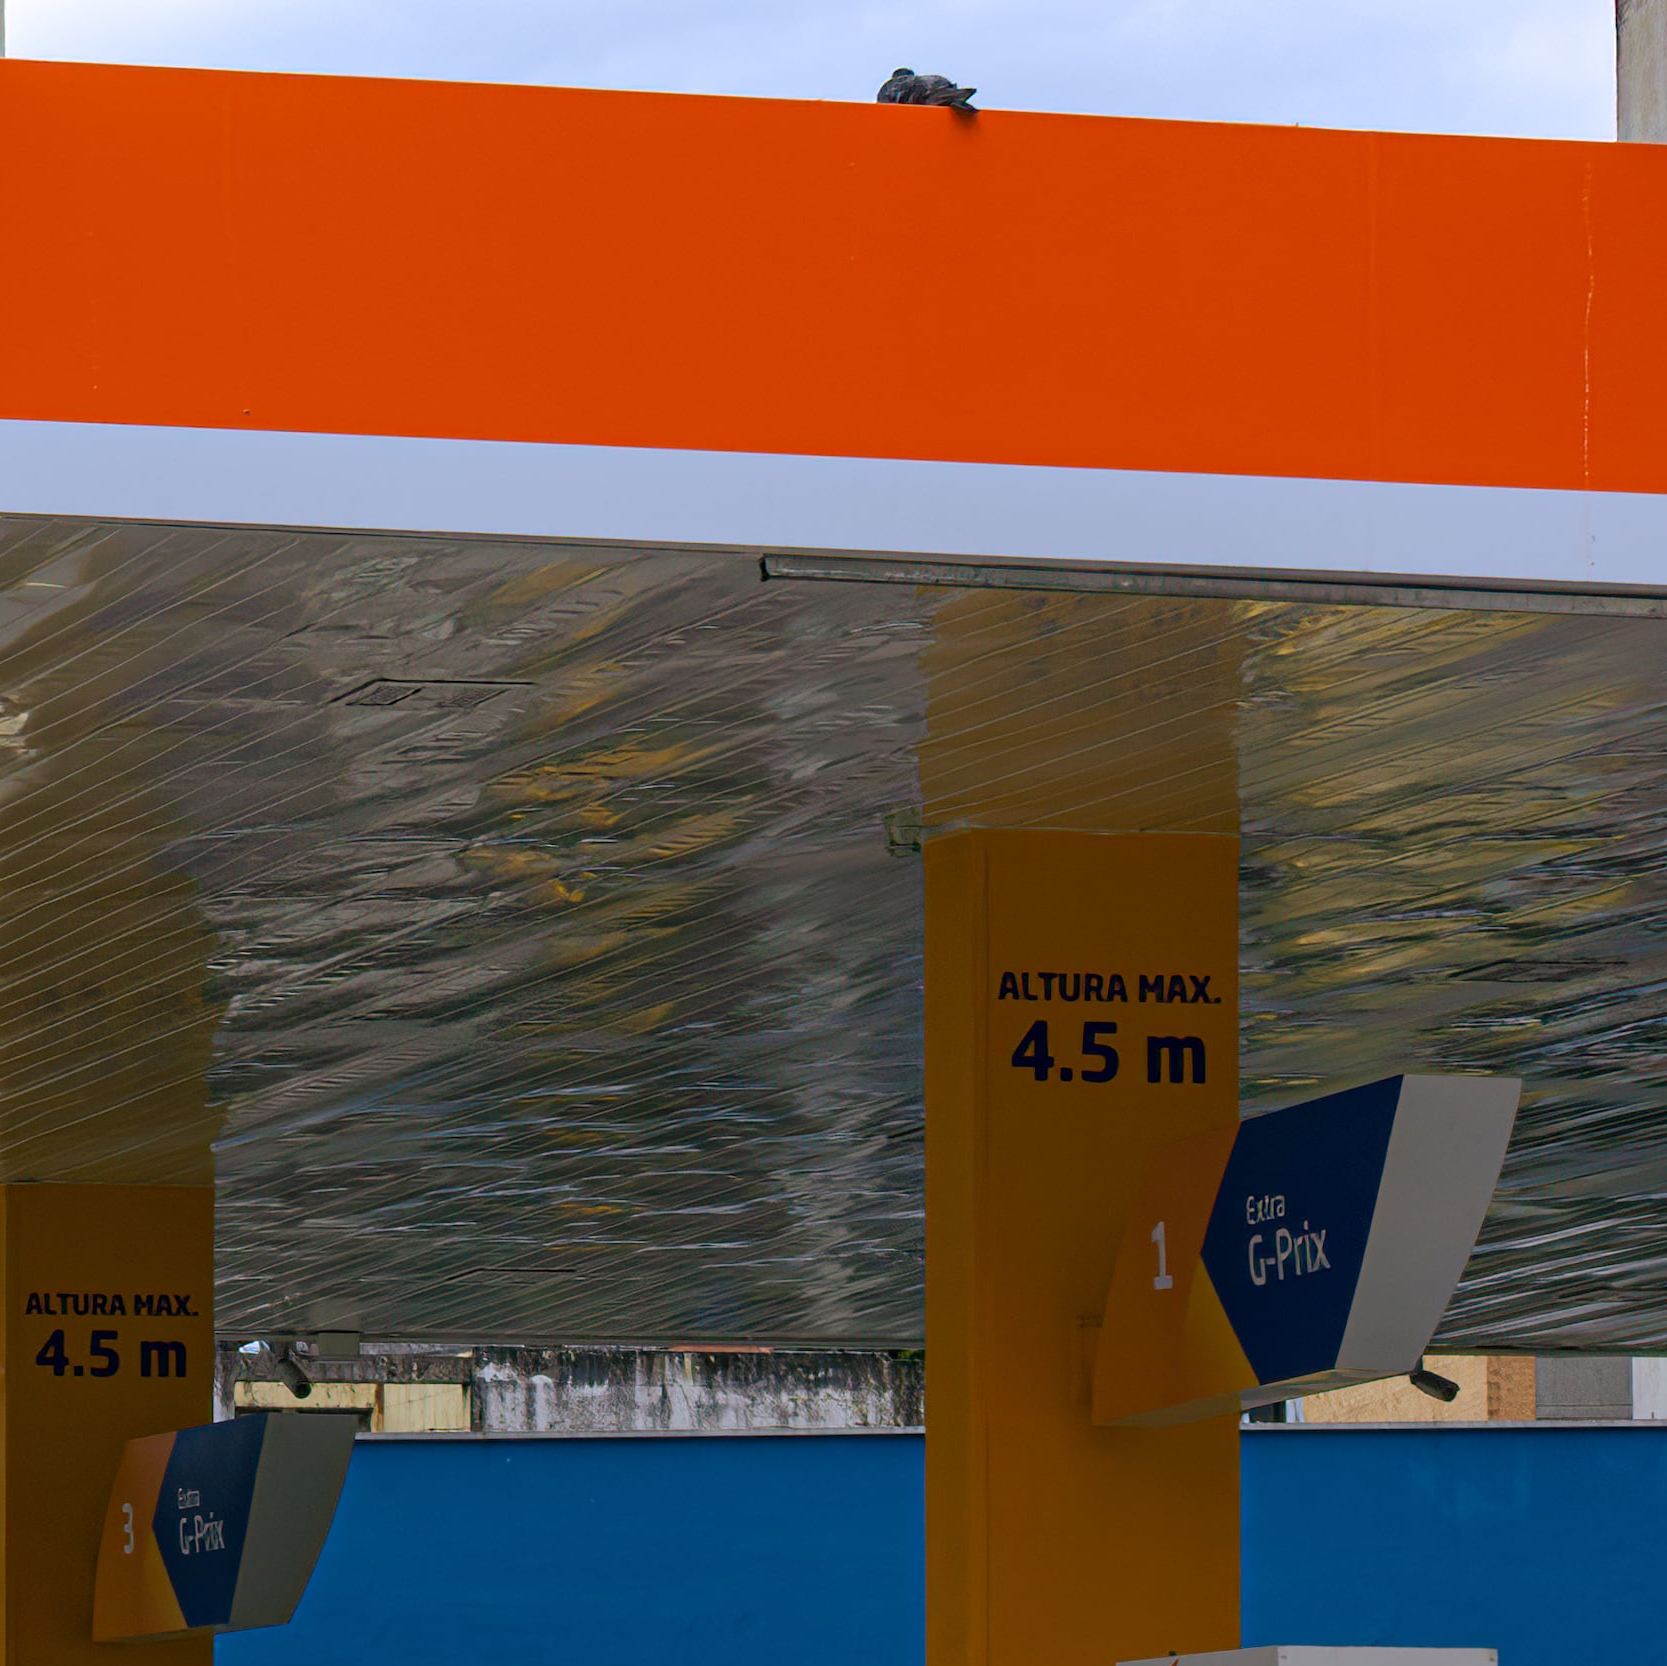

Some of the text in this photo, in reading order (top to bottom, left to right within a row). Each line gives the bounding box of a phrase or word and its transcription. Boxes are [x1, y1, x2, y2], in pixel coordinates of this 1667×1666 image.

[997, 970, 1222, 1005] ALTURA MAX.
[1010, 1018, 1207, 1085] 4.5 m
[1245, 1193, 1286, 1224] Extra
[1150, 1220, 1174, 1291] 1
[1247, 1219, 1332, 1287] G-Prix
[25, 1291, 200, 1318] ALTURA MAX.
[35, 1329, 188, 1378] 4.5 m
[121, 1502, 135, 1555] 3
[178, 1511, 227, 1556] G-Prix
